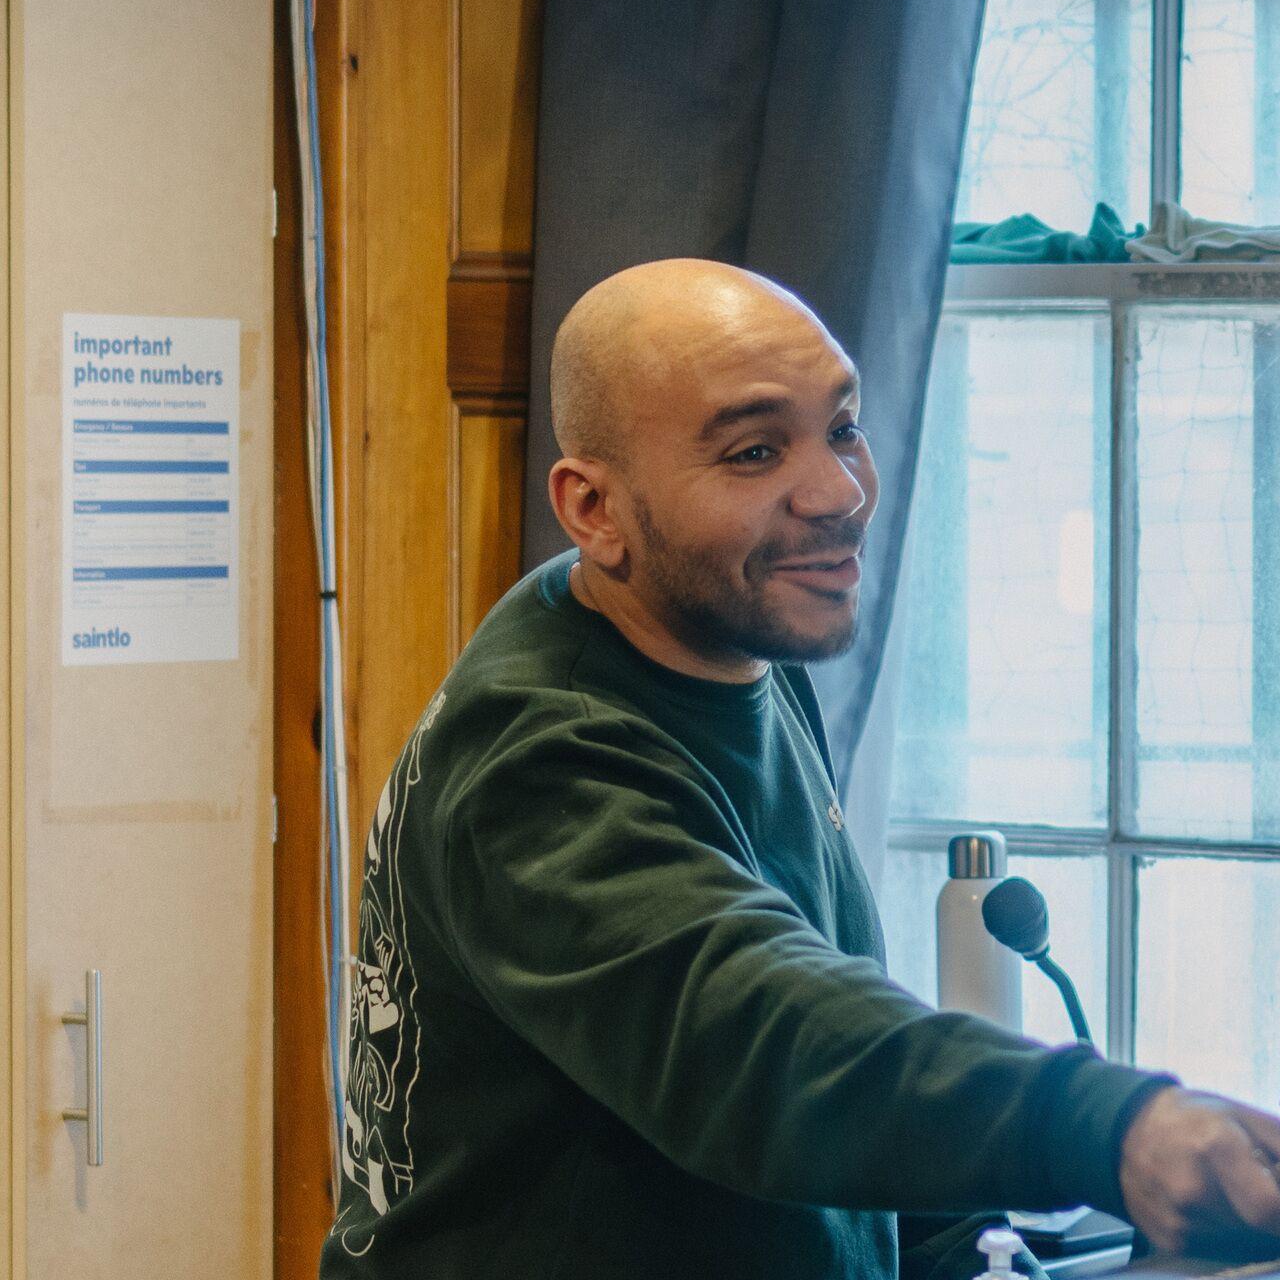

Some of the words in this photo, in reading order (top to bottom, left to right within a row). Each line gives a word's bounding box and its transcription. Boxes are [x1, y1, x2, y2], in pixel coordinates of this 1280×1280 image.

[74, 331, 173, 359] important
[74, 361, 135, 388] phone
[140, 363, 224, 387] numbers
[73, 626, 131, 648] saintlo
